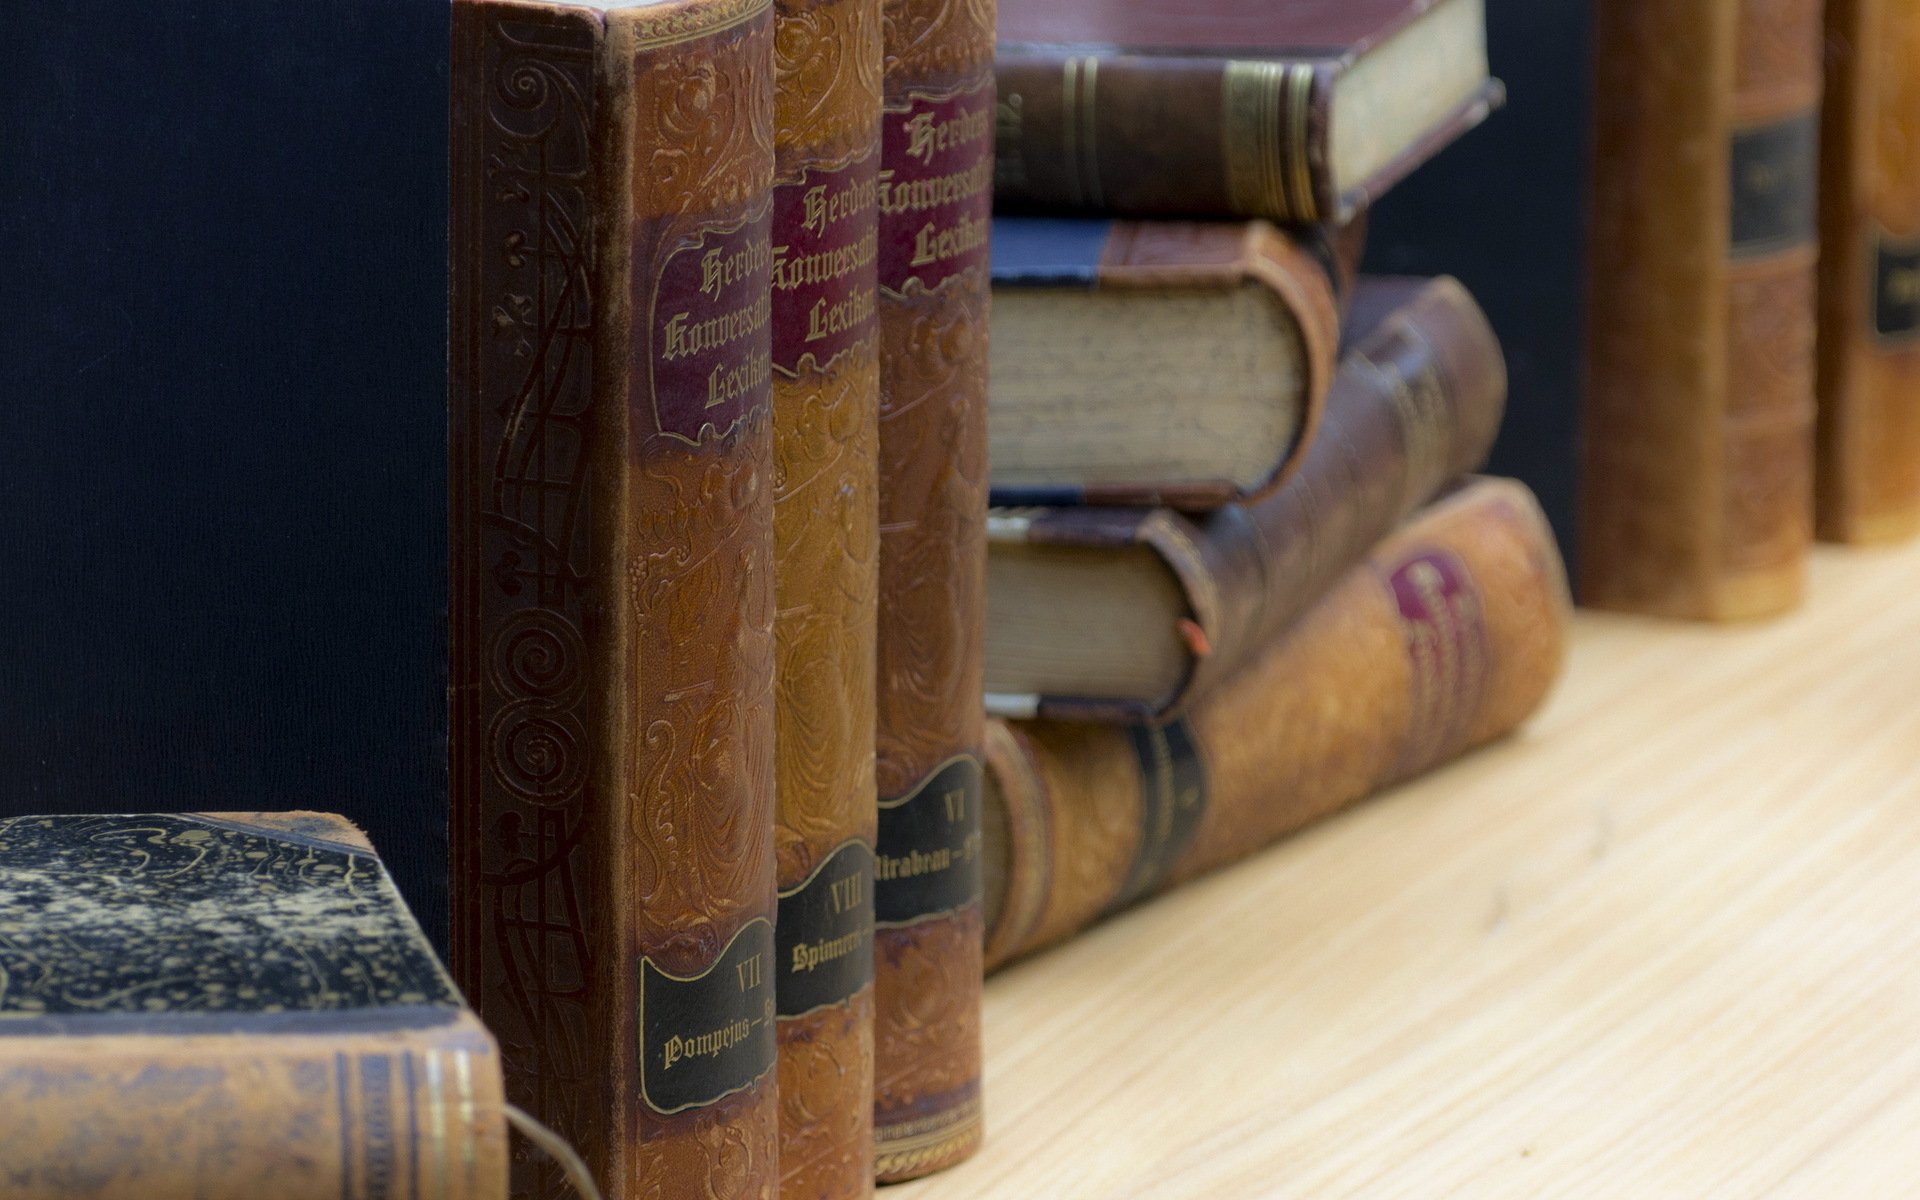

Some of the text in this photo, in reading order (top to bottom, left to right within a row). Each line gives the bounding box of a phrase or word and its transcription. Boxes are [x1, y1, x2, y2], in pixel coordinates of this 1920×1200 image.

[704, 346, 770, 408] Lexikon
[944, 788, 965, 822] VI
[831, 872, 862, 914] VIII
[736, 952, 762, 993] VII
